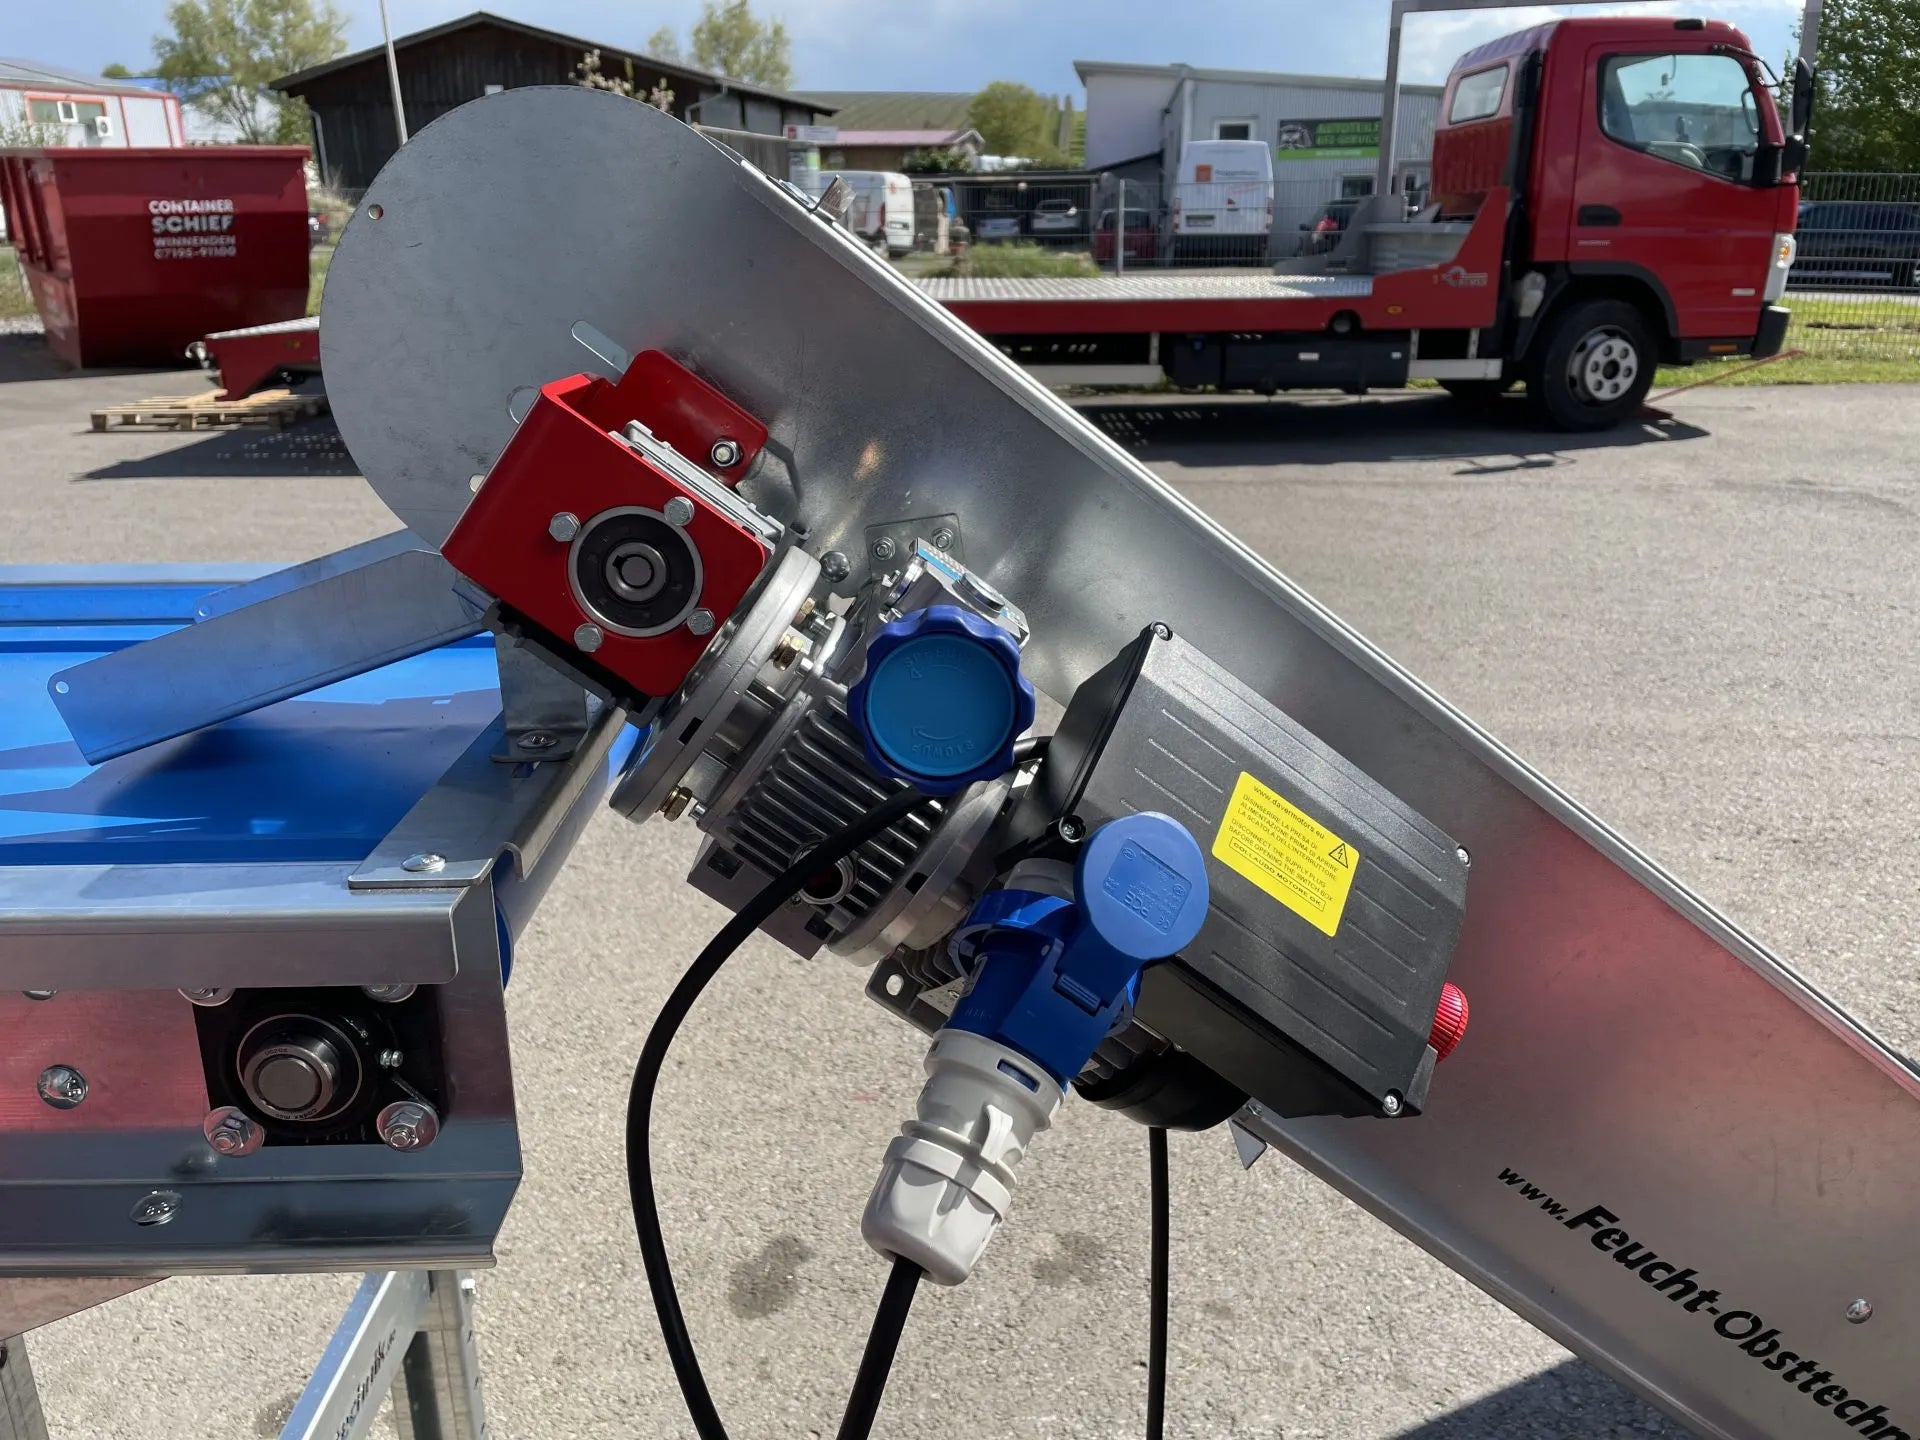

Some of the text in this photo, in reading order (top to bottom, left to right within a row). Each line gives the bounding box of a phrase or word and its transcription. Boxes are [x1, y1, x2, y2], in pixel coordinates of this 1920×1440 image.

[148, 199, 234, 214] CONTAINER
[152, 214, 233, 234] SCHIEF
[1237, 808, 1247, 817] LA
[1247, 814, 1276, 838] SCATOLA
[1240, 802, 1338, 873] ALIMENTAZIONE PRIMA DI APRIRE
[1243, 794, 1280, 823] DISINSERIRE
[1281, 821, 1290, 830] LA
[1290, 828, 1310, 845] PRESA
[1231, 819, 1326, 888] DISCONNECT THE SUPPLY PLUG
[1233, 842, 1321, 906] COLLAUDO MOTORE OK
[1254, 842, 1284, 867] OPENING
[1284, 862, 1296, 875] THE
[1295, 870, 1320, 892] SWITCH
[1320, 888, 1333, 902] BOX
